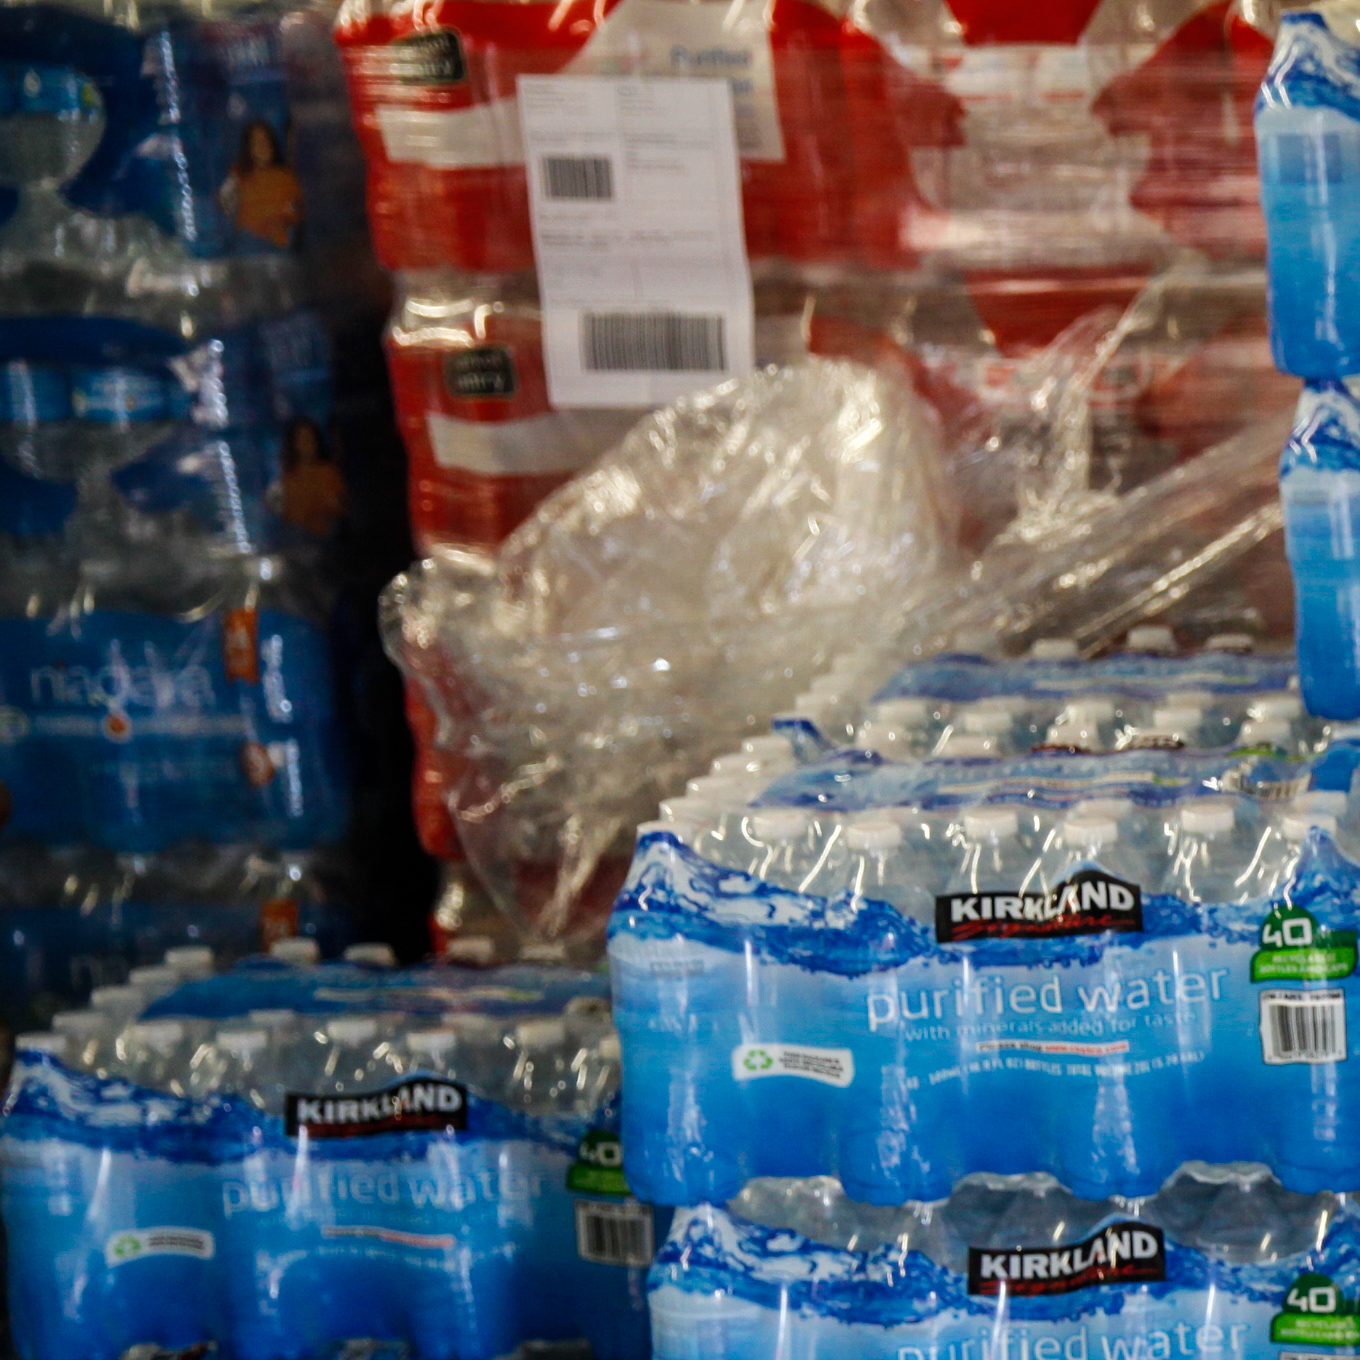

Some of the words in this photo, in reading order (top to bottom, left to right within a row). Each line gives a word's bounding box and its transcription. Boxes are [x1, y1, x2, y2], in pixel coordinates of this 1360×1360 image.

[951, 880, 1135, 923] KIRKLAND
[1262, 917, 1313, 948] 40
[868, 975, 1063, 1033] purified
[1077, 967, 1231, 1013] water
[299, 1083, 464, 1125] KIRKLAND
[980, 1228, 1159, 1281] KIRKLAND
[1287, 1287, 1337, 1313] 40
